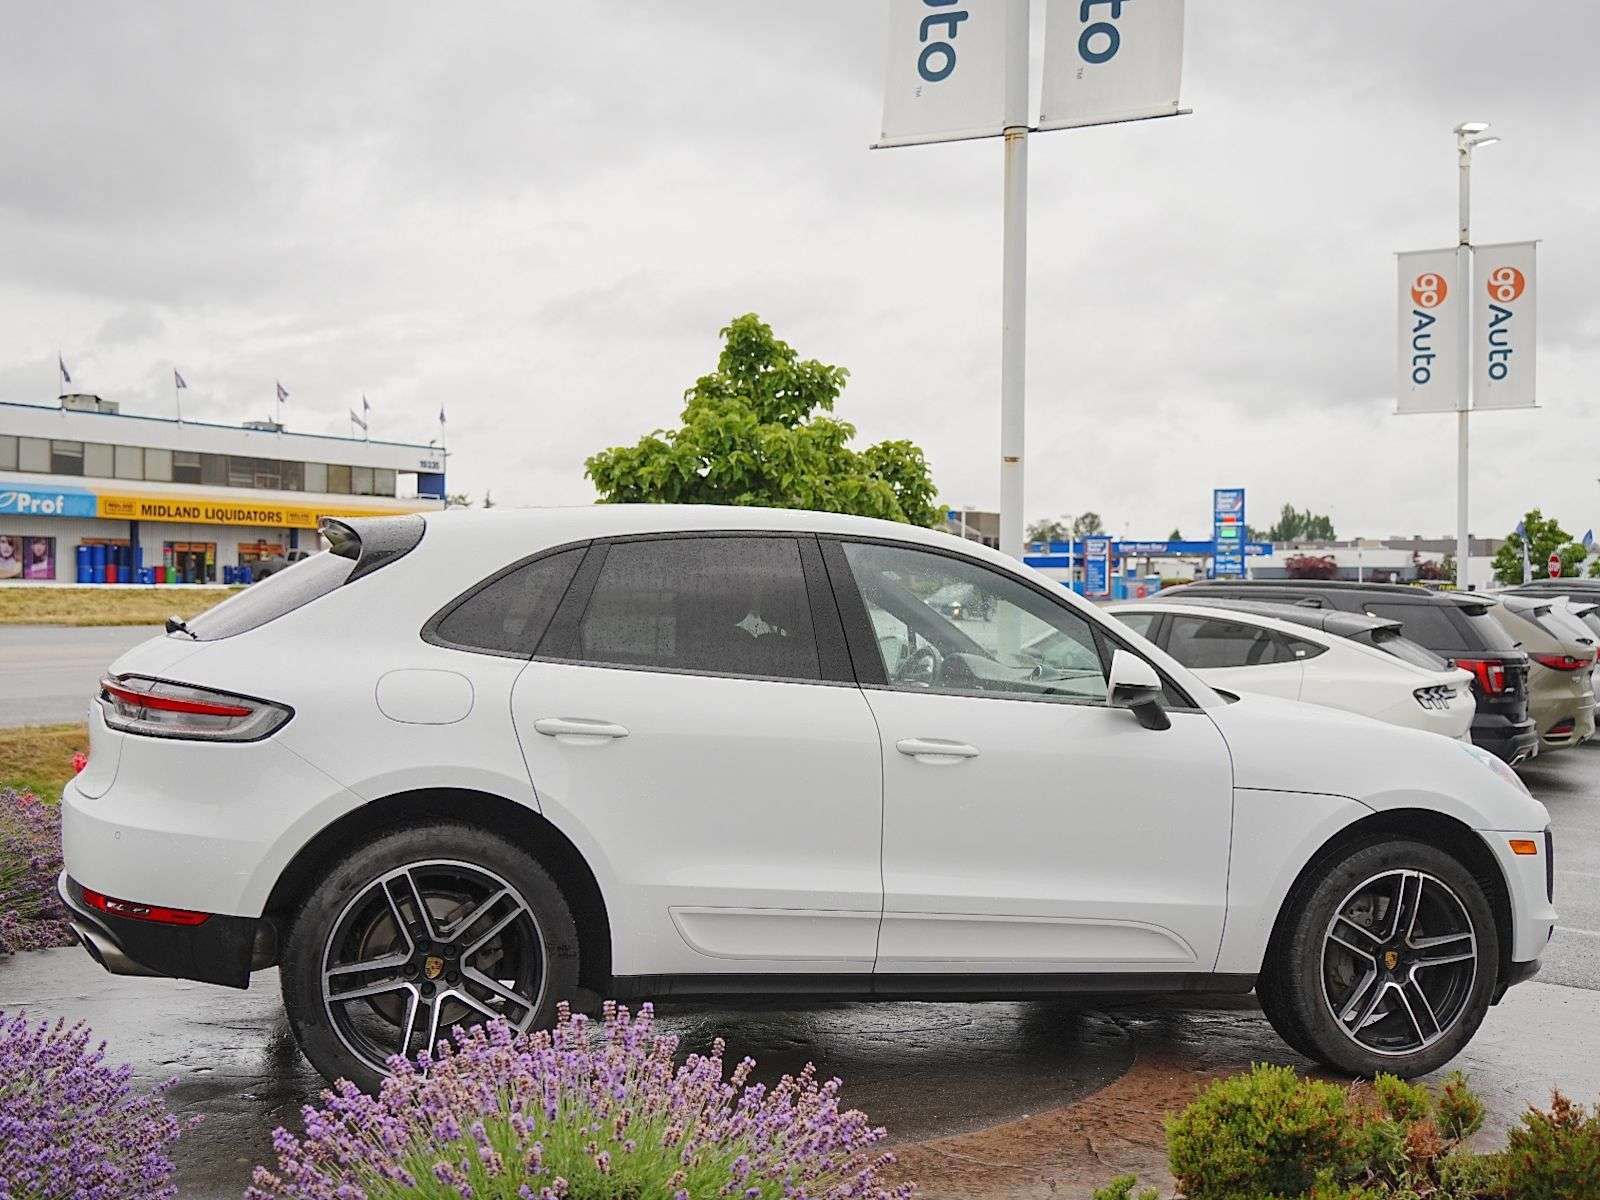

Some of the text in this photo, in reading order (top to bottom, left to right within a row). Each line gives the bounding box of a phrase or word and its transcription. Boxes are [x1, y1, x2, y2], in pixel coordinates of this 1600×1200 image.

[918, 0, 968, 82] to
[1412, 309, 1436, 385] Auto
[1488, 304, 1513, 380] Auto
[17, 493, 65, 514] Prof
[141, 504, 201, 519] MIDLAND
[205, 507, 283, 523] LIQUIDATORS
